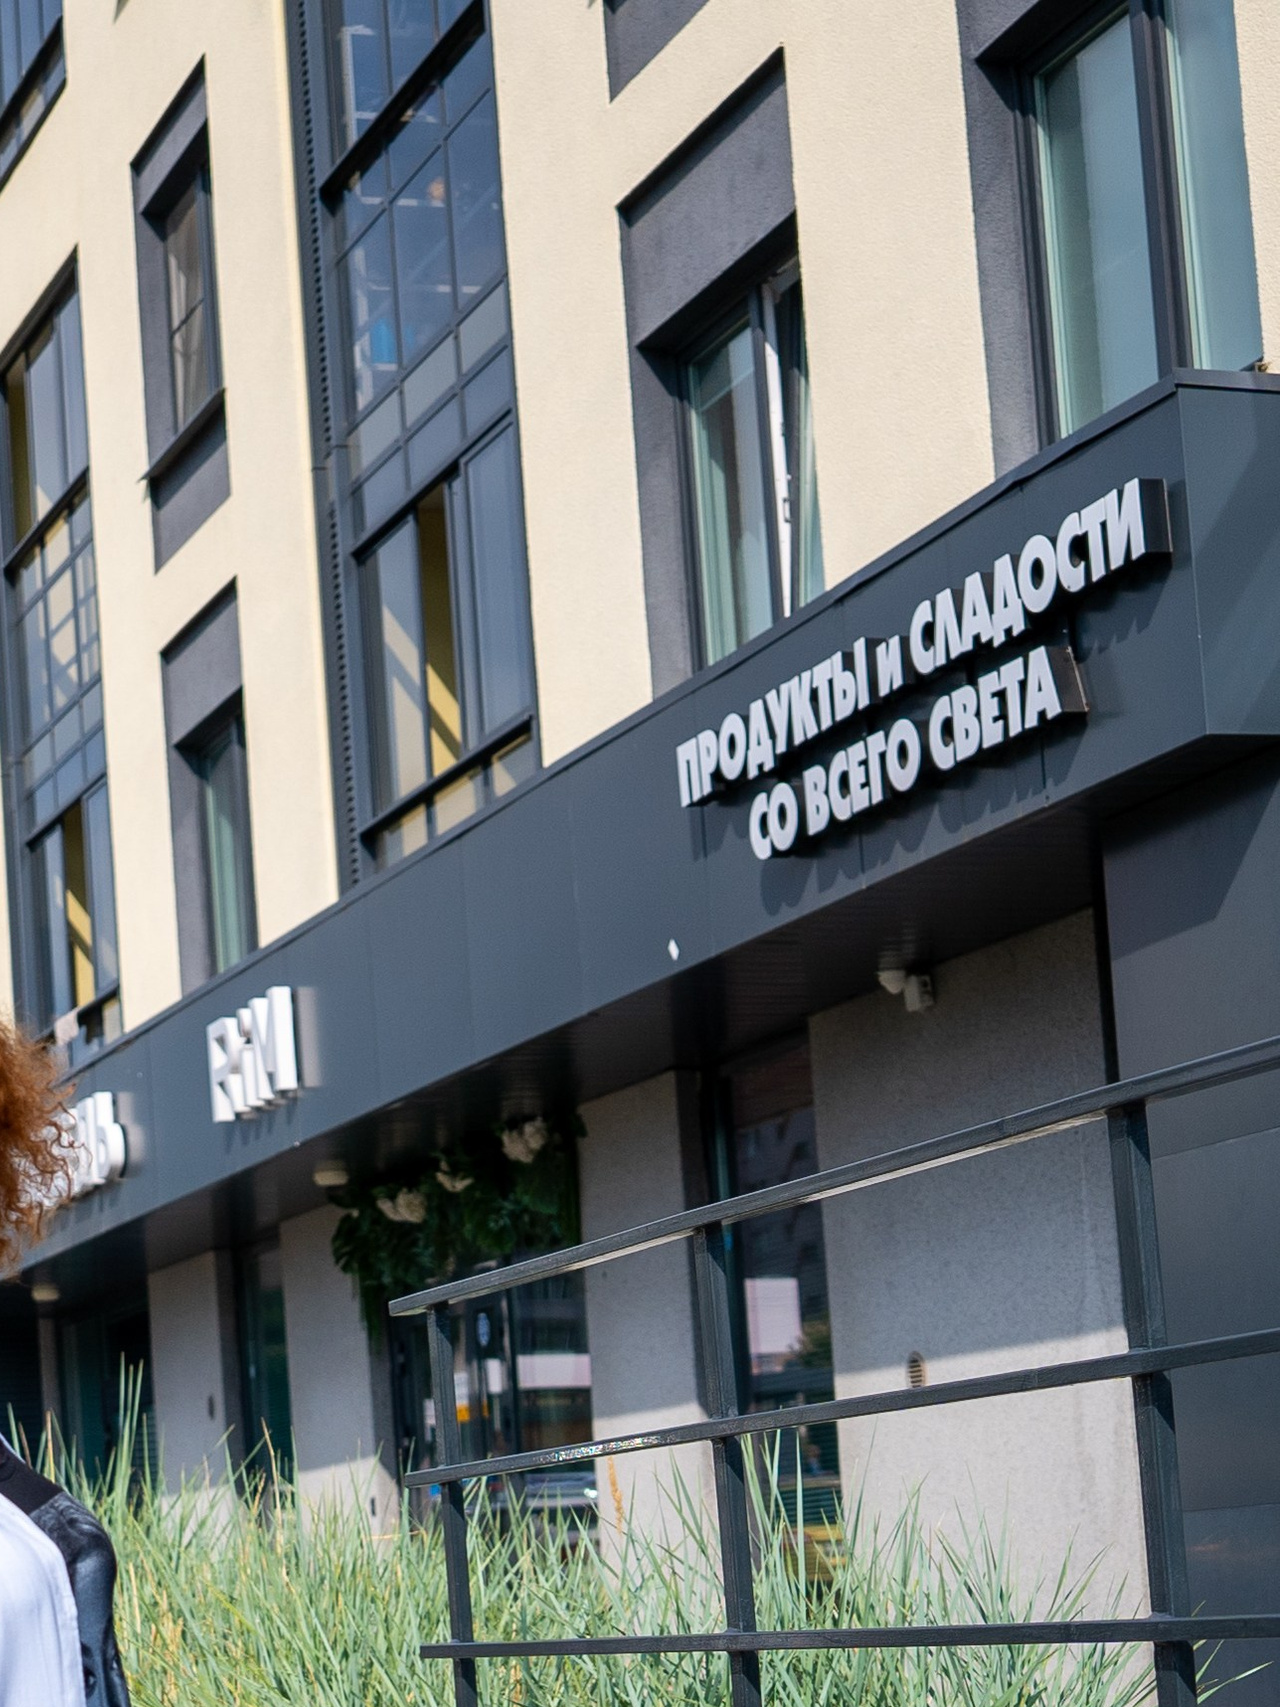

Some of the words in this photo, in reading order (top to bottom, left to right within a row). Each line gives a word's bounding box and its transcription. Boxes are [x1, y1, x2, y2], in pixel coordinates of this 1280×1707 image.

[676, 636, 870, 807] ПРОДУКТЫ
[876, 635, 904, 698] и
[909, 477, 1146, 675] СЛАДОСТИ
[749, 783, 799, 860] СО
[803, 718, 920, 836] ВСЕГО
[929, 646, 1062, 770] СВЕТА
